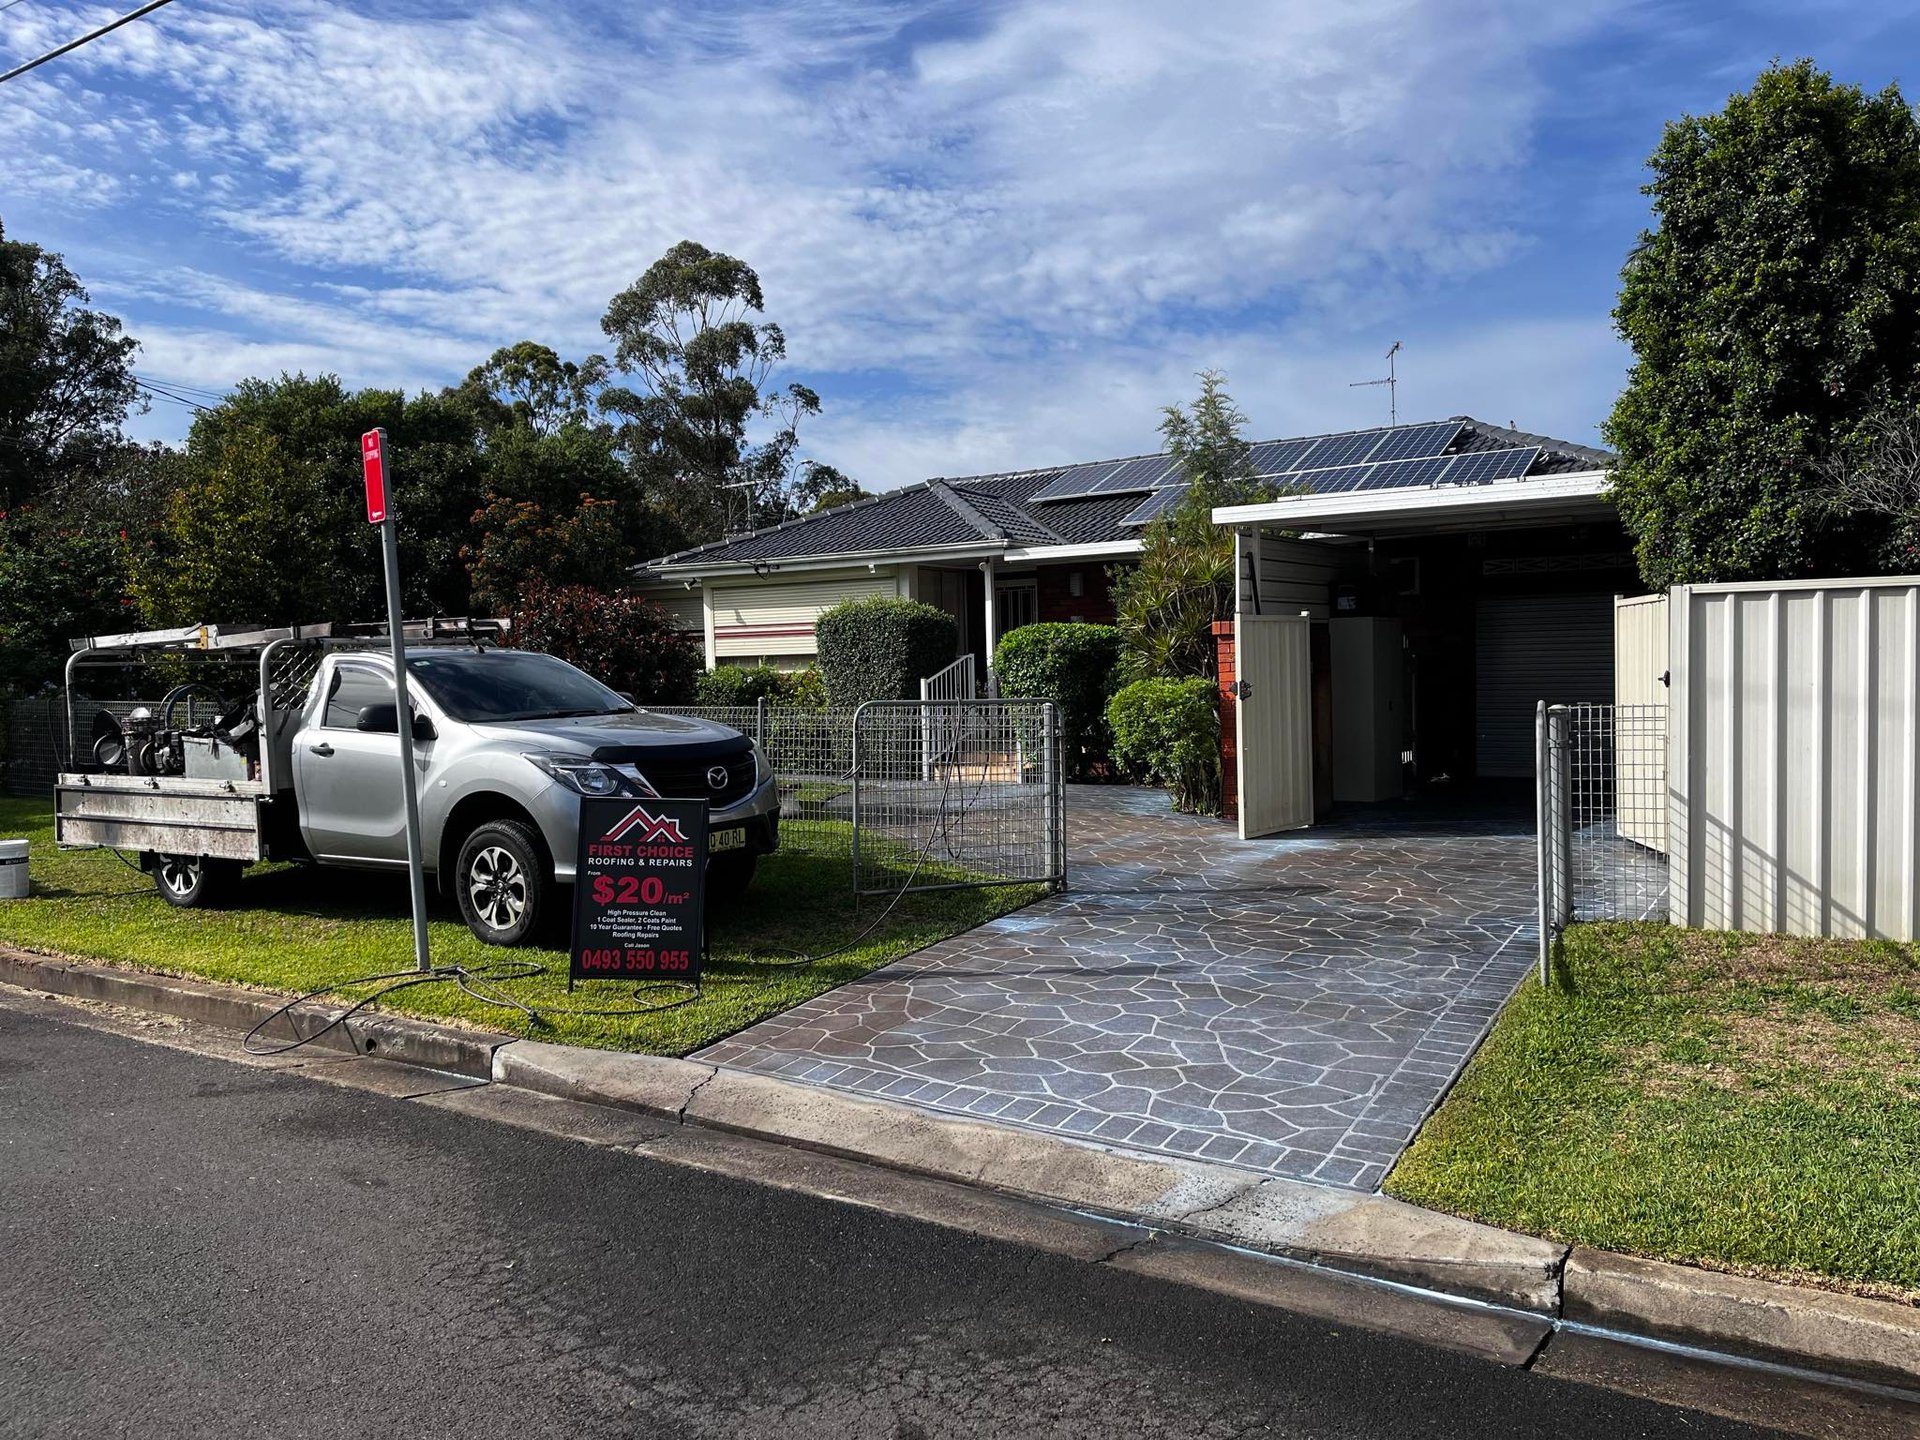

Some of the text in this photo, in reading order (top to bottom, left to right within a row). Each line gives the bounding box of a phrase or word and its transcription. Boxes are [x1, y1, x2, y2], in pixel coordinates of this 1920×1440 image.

[588, 844, 694, 858] FIRST CHOICE
[638, 858, 645, 866] &
[649, 859, 693, 867] REPAIRS
[581, 949, 689, 970] 0493 550 955
